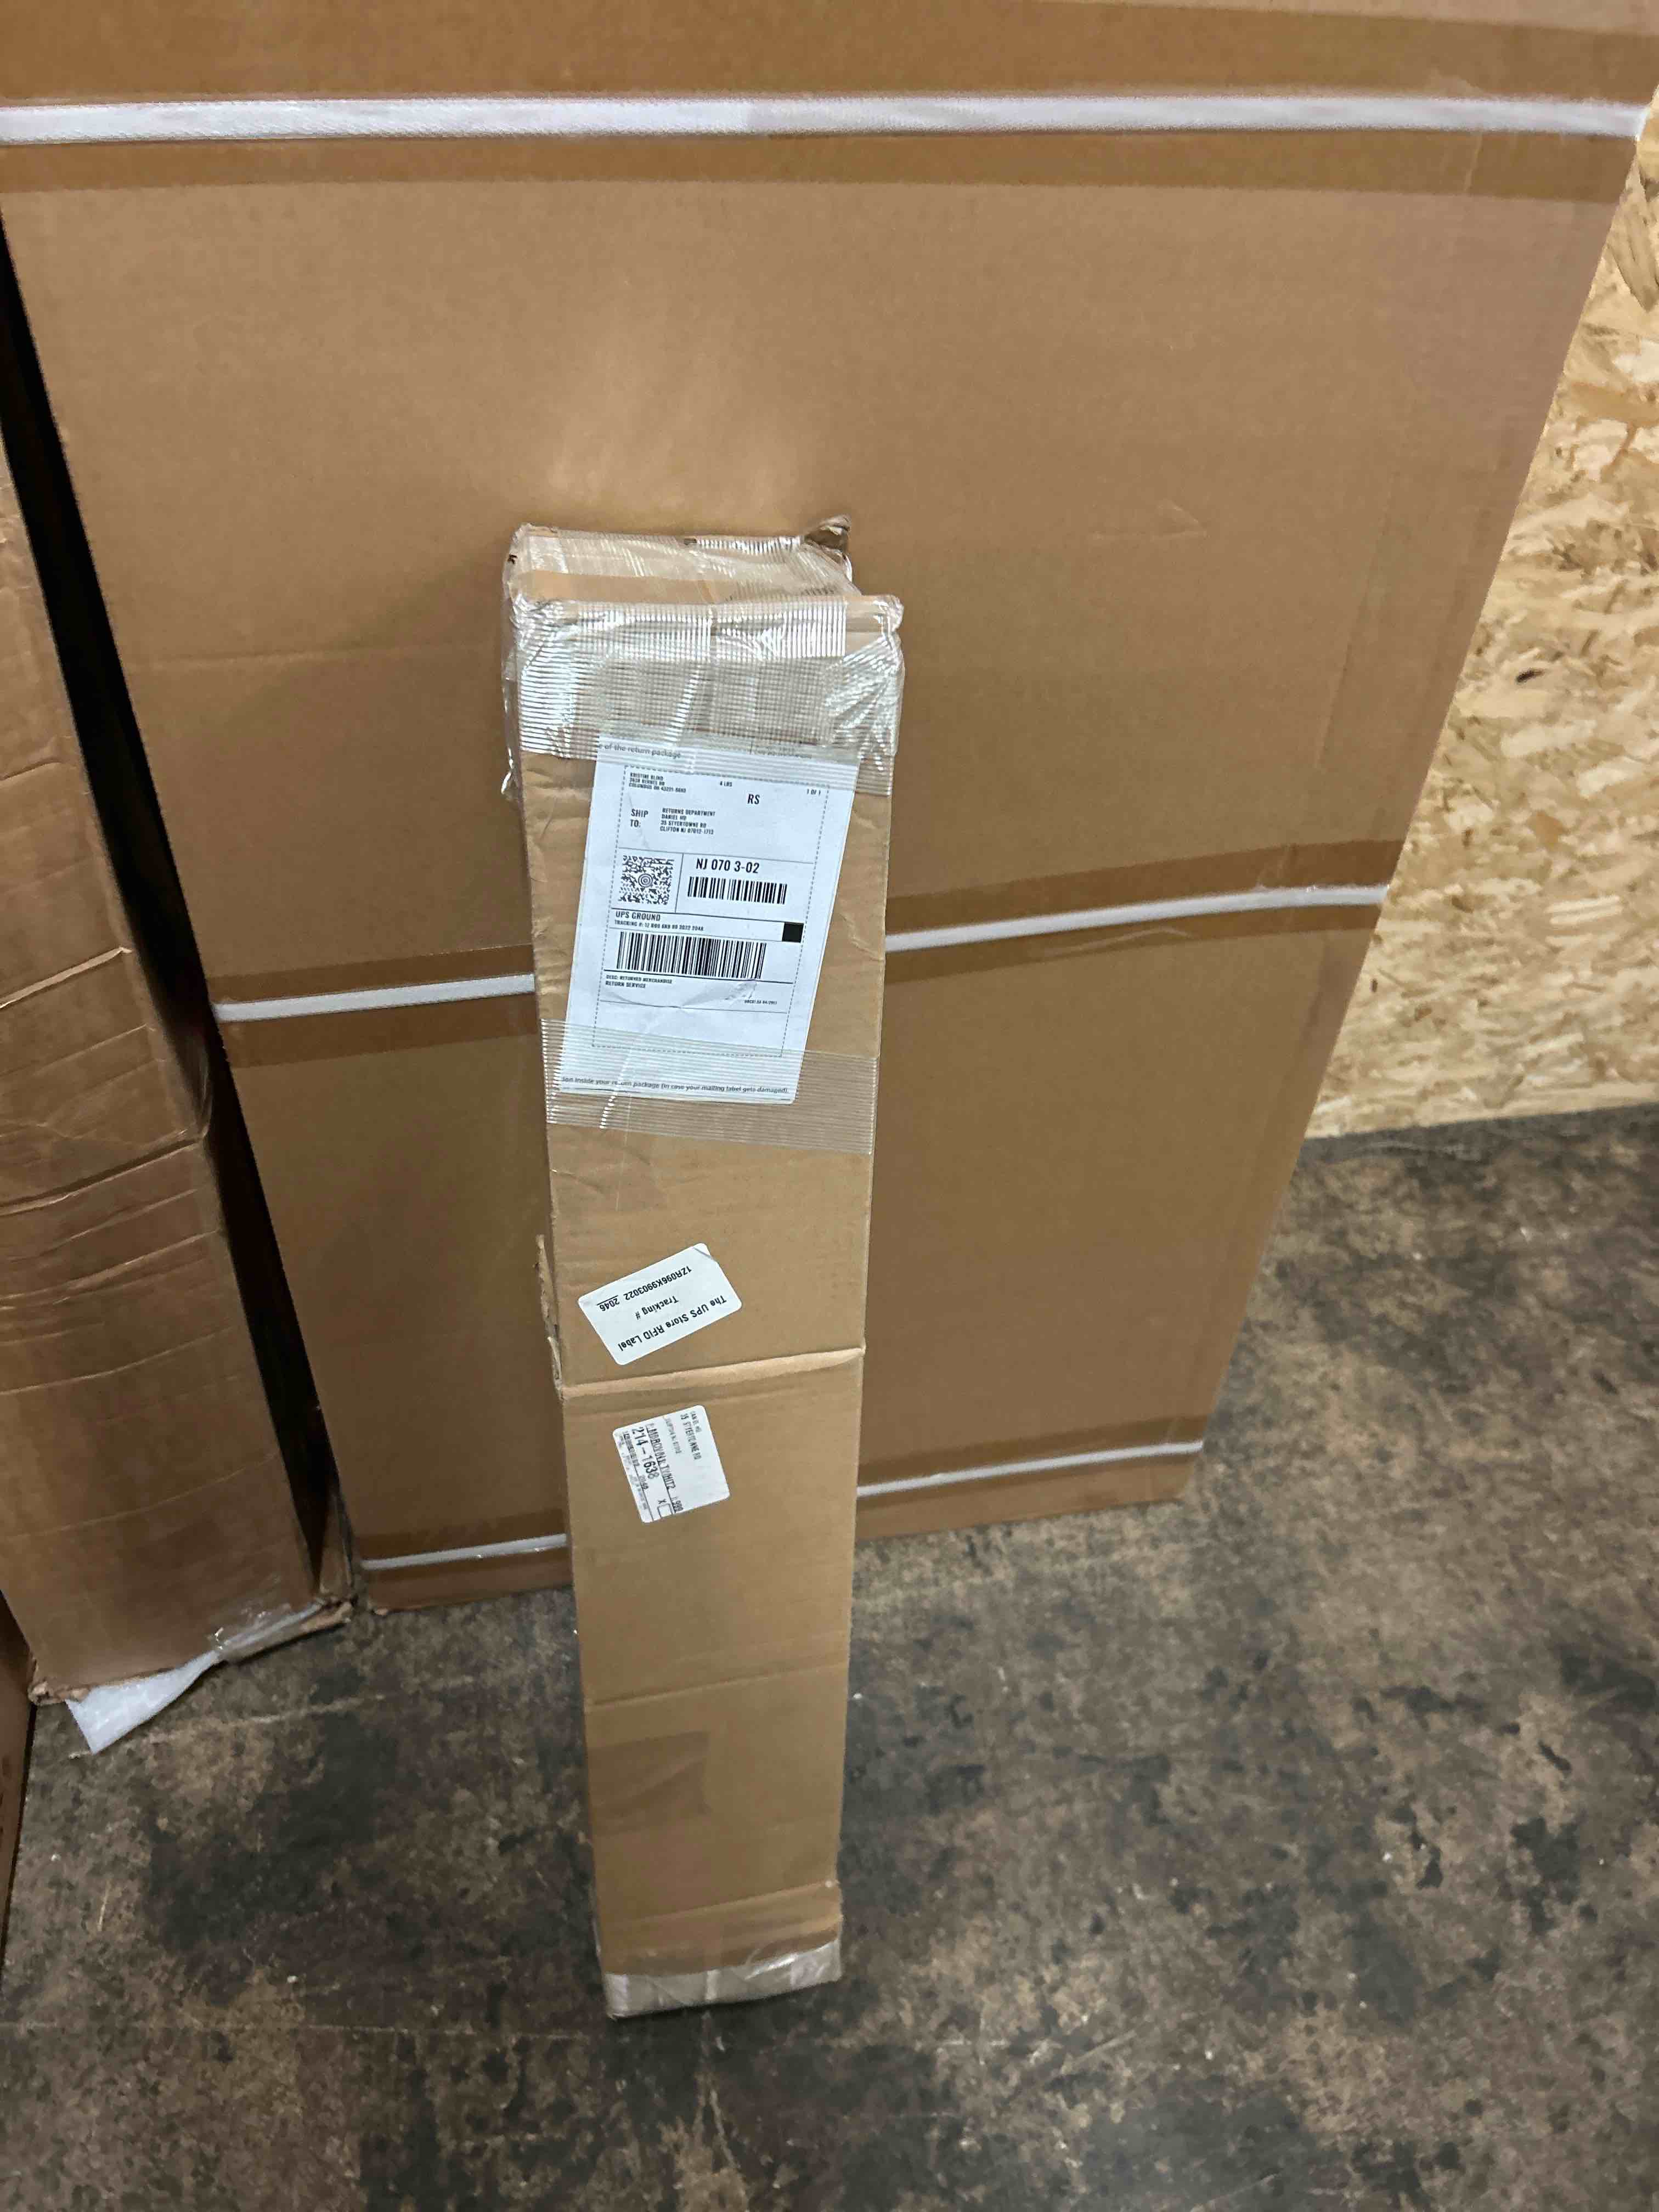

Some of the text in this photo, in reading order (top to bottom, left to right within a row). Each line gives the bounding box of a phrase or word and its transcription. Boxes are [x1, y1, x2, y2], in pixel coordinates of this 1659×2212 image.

[652, 749, 681, 759] package
[747, 794, 760, 805] RS
[631, 809, 648, 818] SHIP
[685, 809, 715, 817] DEPARTMENT
[630, 819, 641, 828] TO:
[696, 857, 760, 874] NJ 070 3-02
[631, 912, 661, 921] GROUND
[702, 1084, 725, 1092] mailing
[599, 1265, 692, 1312] 1ZR096K9903022 2046
[635, 1295, 679, 1320] Tracking #
[618, 1295, 727, 1351] The UPS Store RFID Label
